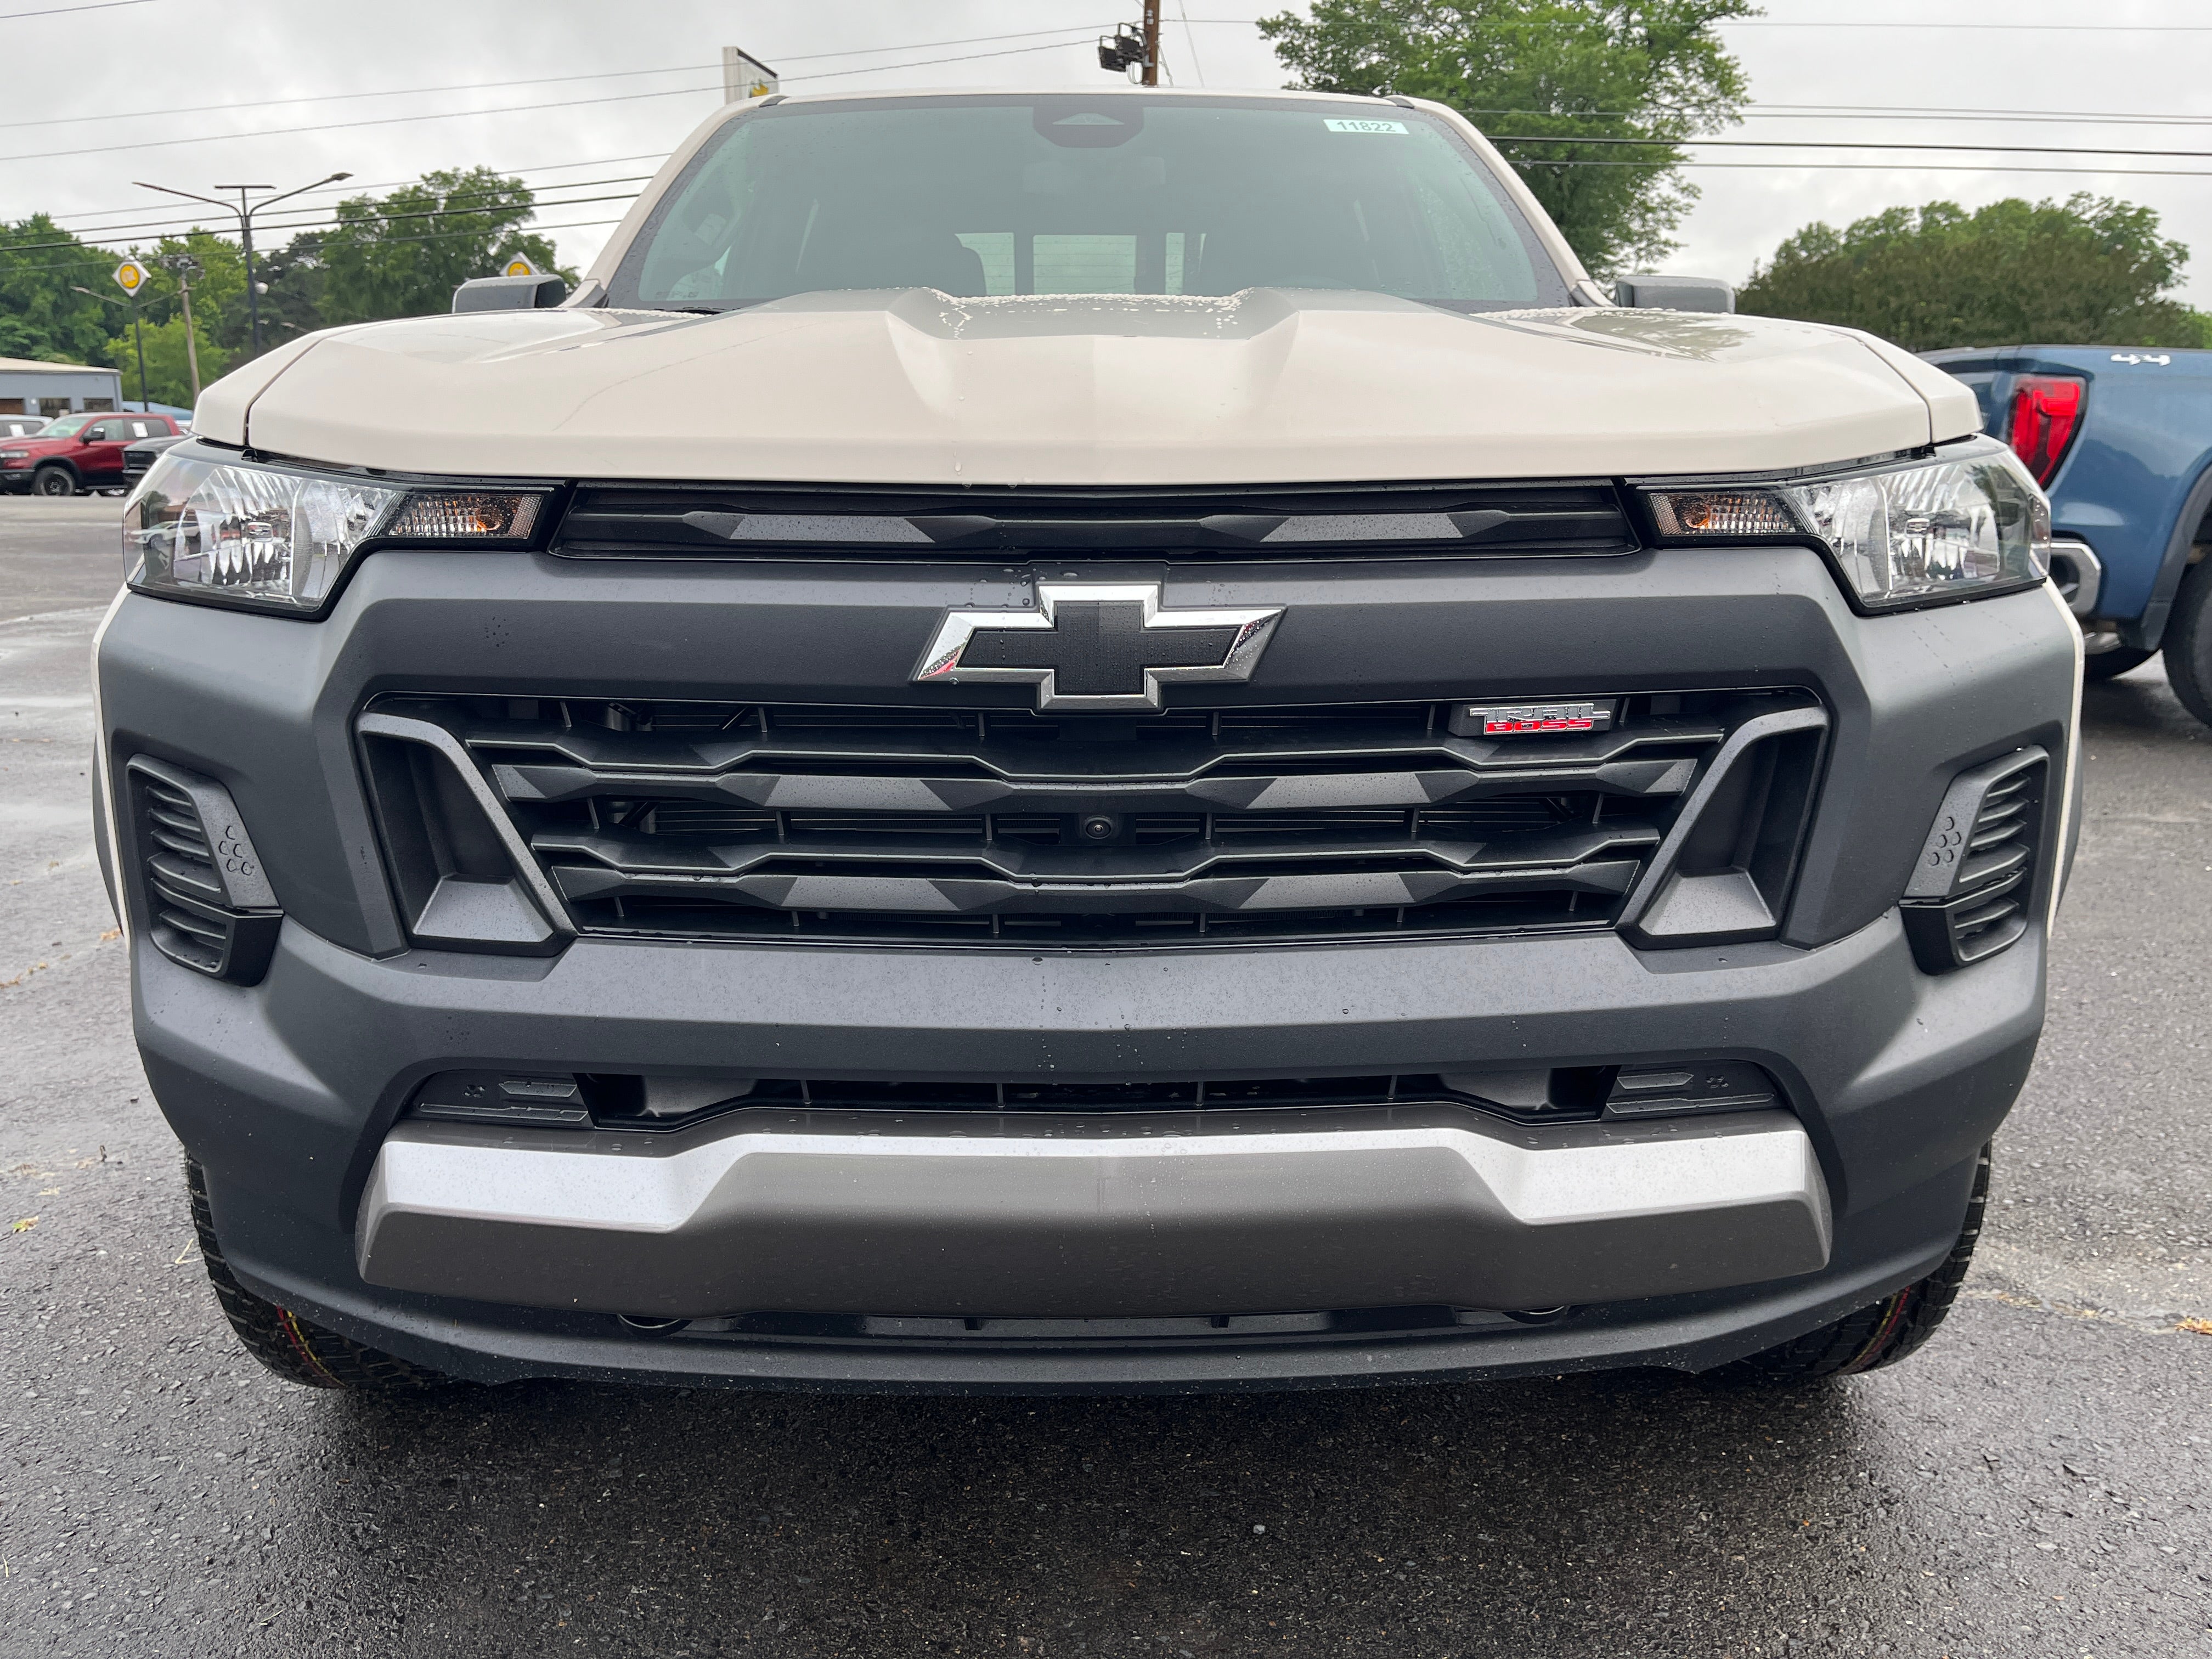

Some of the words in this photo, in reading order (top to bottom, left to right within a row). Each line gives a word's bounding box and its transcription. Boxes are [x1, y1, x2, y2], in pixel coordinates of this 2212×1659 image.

[1336, 121, 1396, 132] 11822
[1470, 703, 1611, 723] TRAIL
[1485, 719, 1593, 733] BOSS
